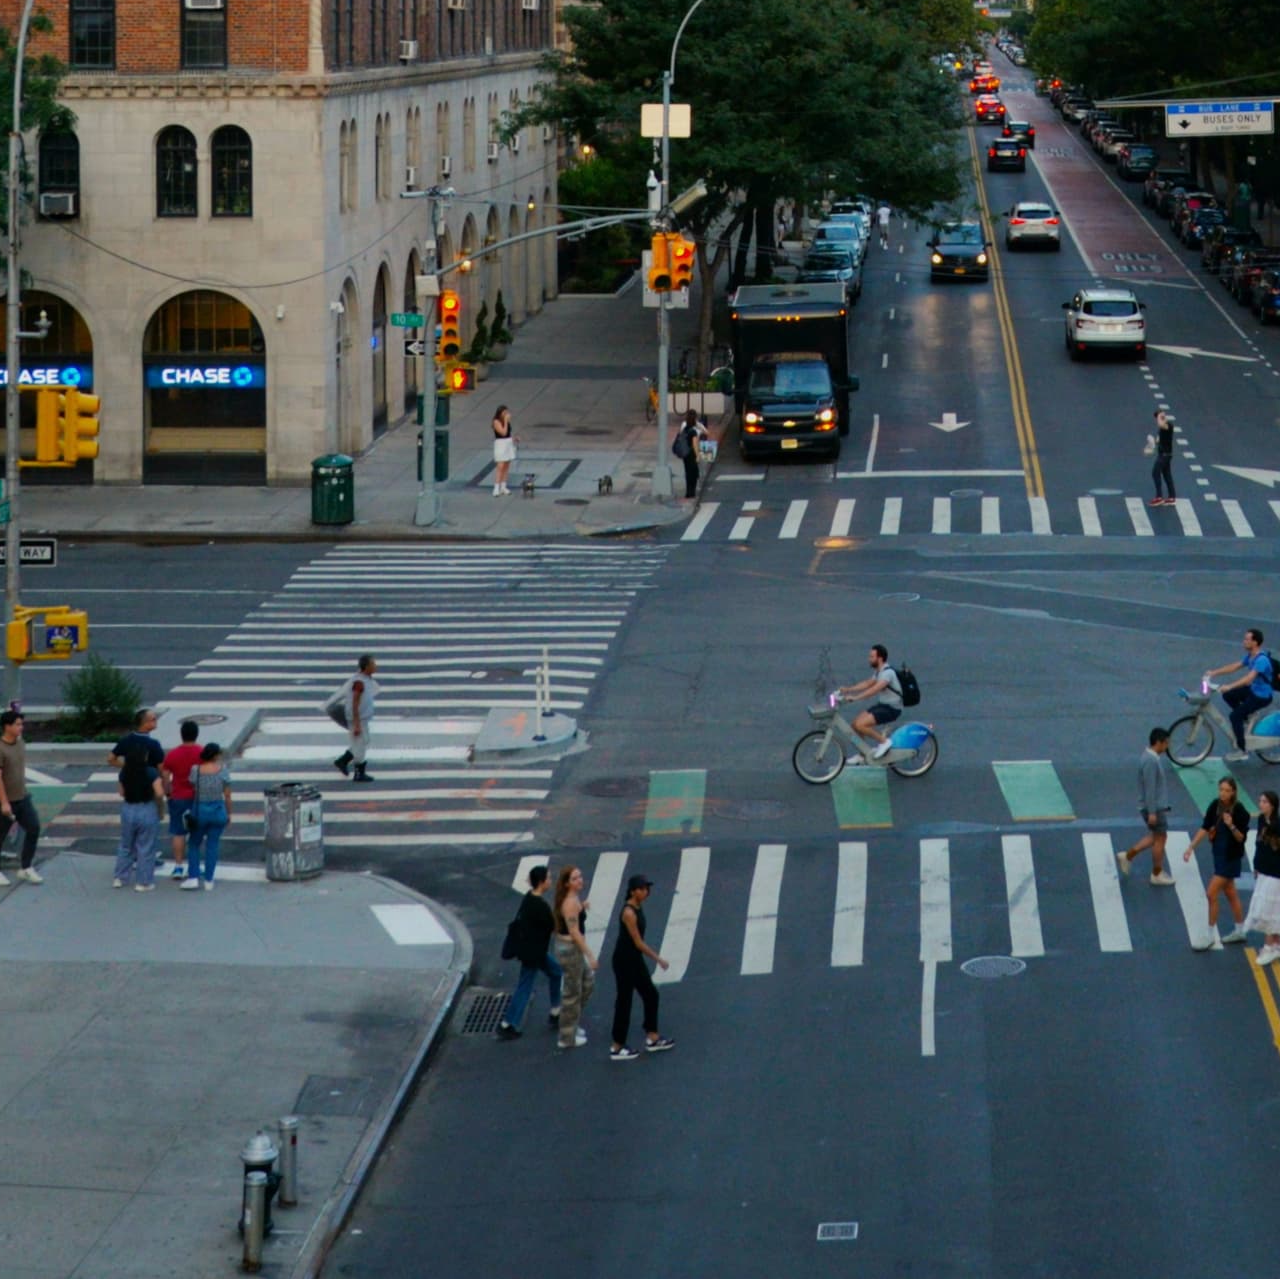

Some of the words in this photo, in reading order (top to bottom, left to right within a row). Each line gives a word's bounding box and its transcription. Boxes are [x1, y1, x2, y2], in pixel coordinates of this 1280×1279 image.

[1203, 114, 1234, 125] BUSES
[1237, 112, 1261, 123] ONLY
[162, 368, 231, 384] CHASE
[23, 548, 47, 558] WAY
